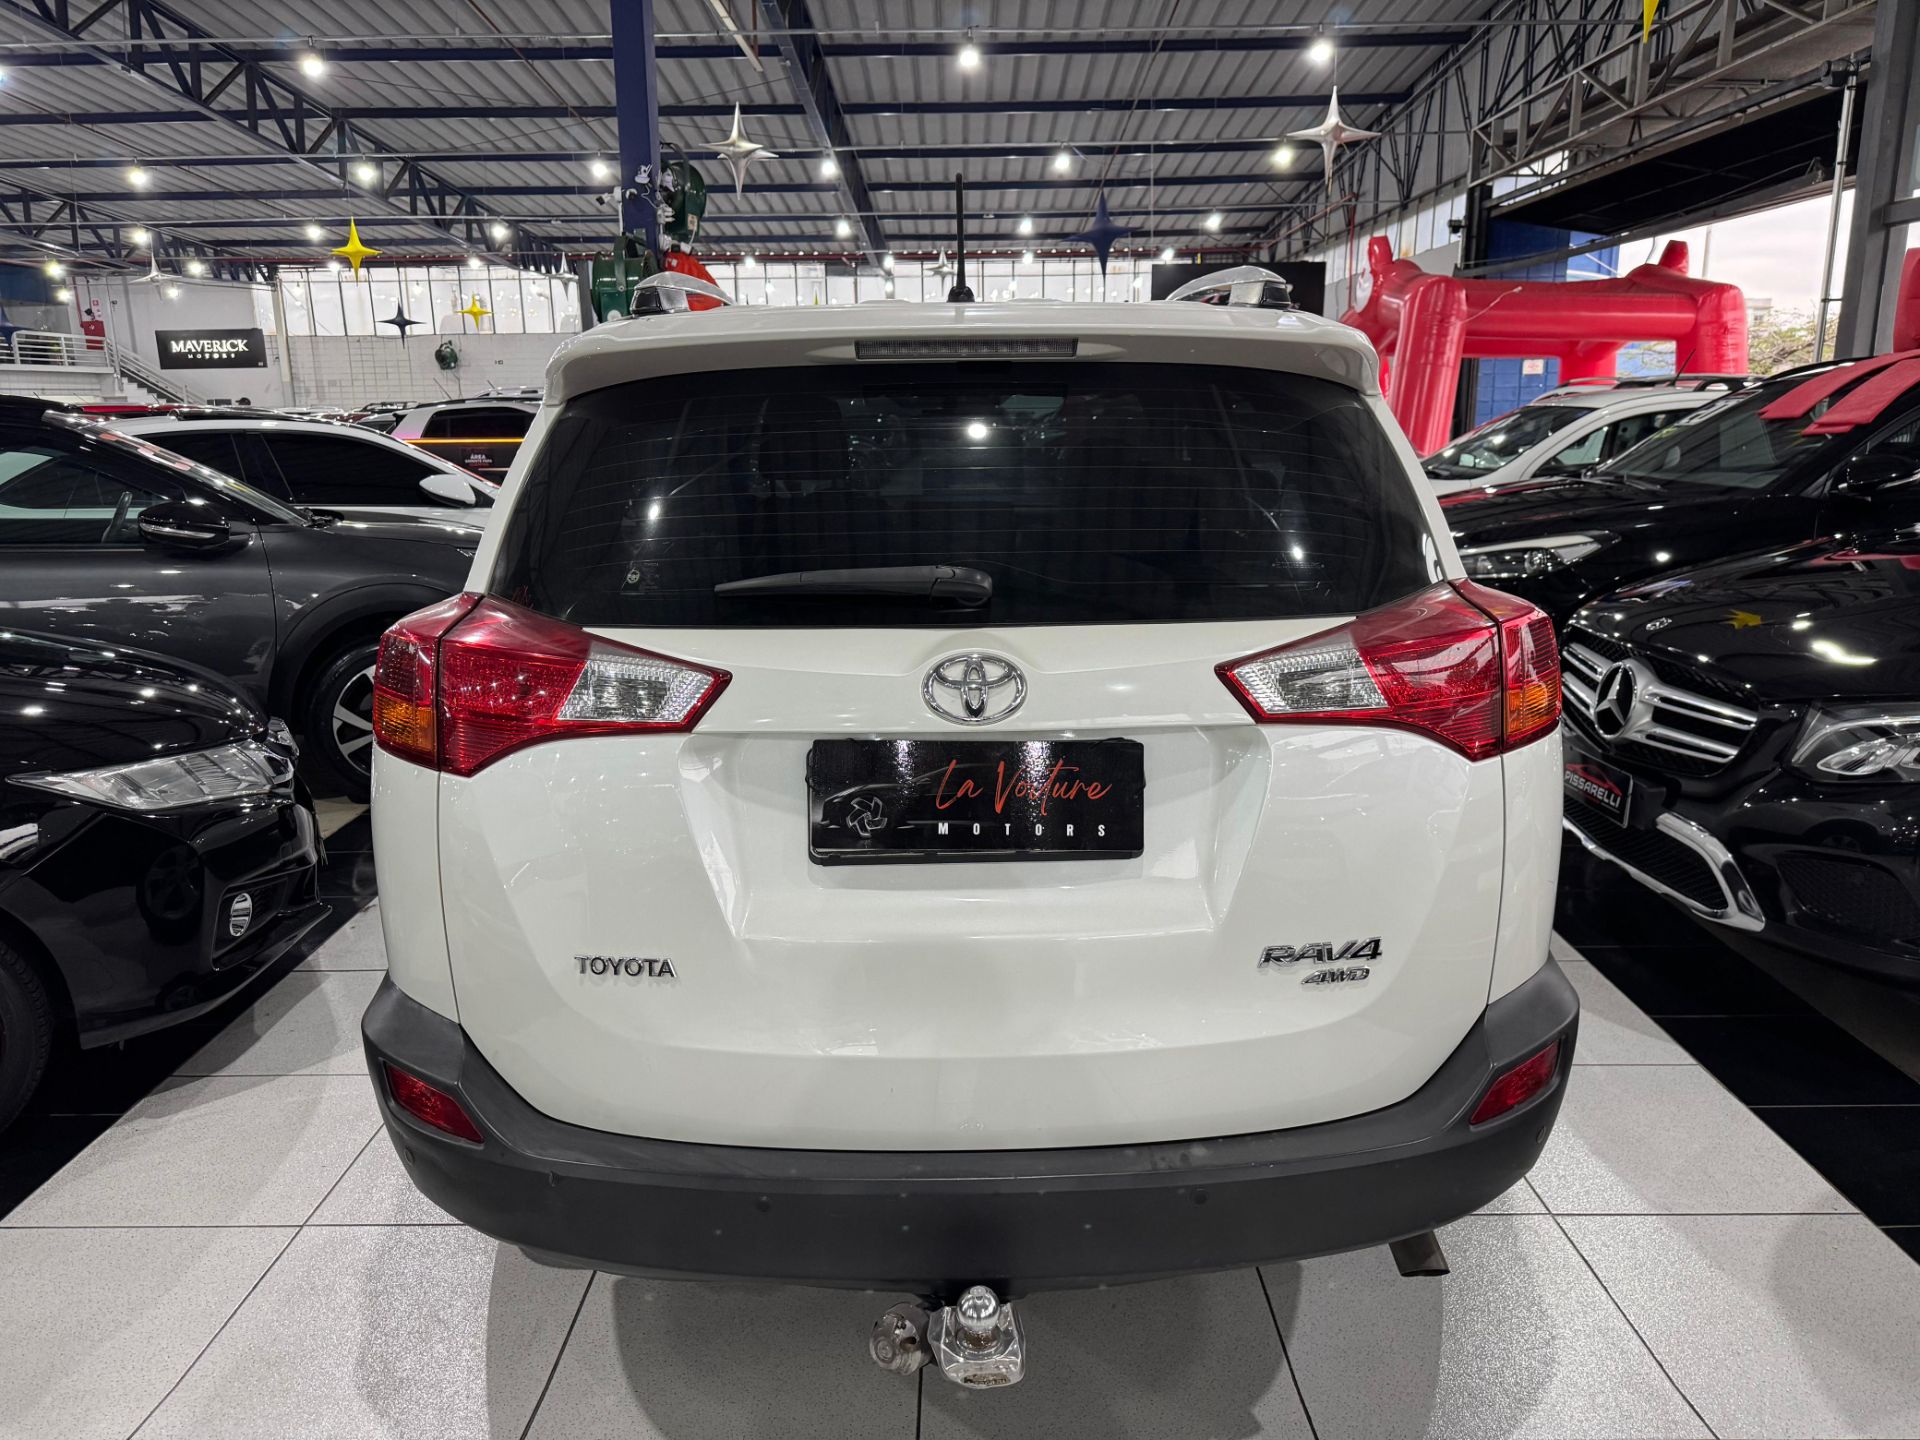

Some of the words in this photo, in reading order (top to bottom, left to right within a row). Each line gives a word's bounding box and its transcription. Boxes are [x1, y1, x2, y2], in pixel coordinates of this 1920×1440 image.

[170, 339, 249, 353] MAVERICK
[935, 759, 983, 810] La
[995, 760, 1112, 816] Voiture
[1565, 770, 1621, 808] PISSARELLI
[938, 822, 1106, 837] MOTORS
[1257, 936, 1382, 968] RAV4
[574, 956, 677, 978] TOYOTA
[1301, 965, 1370, 985] 4WD
